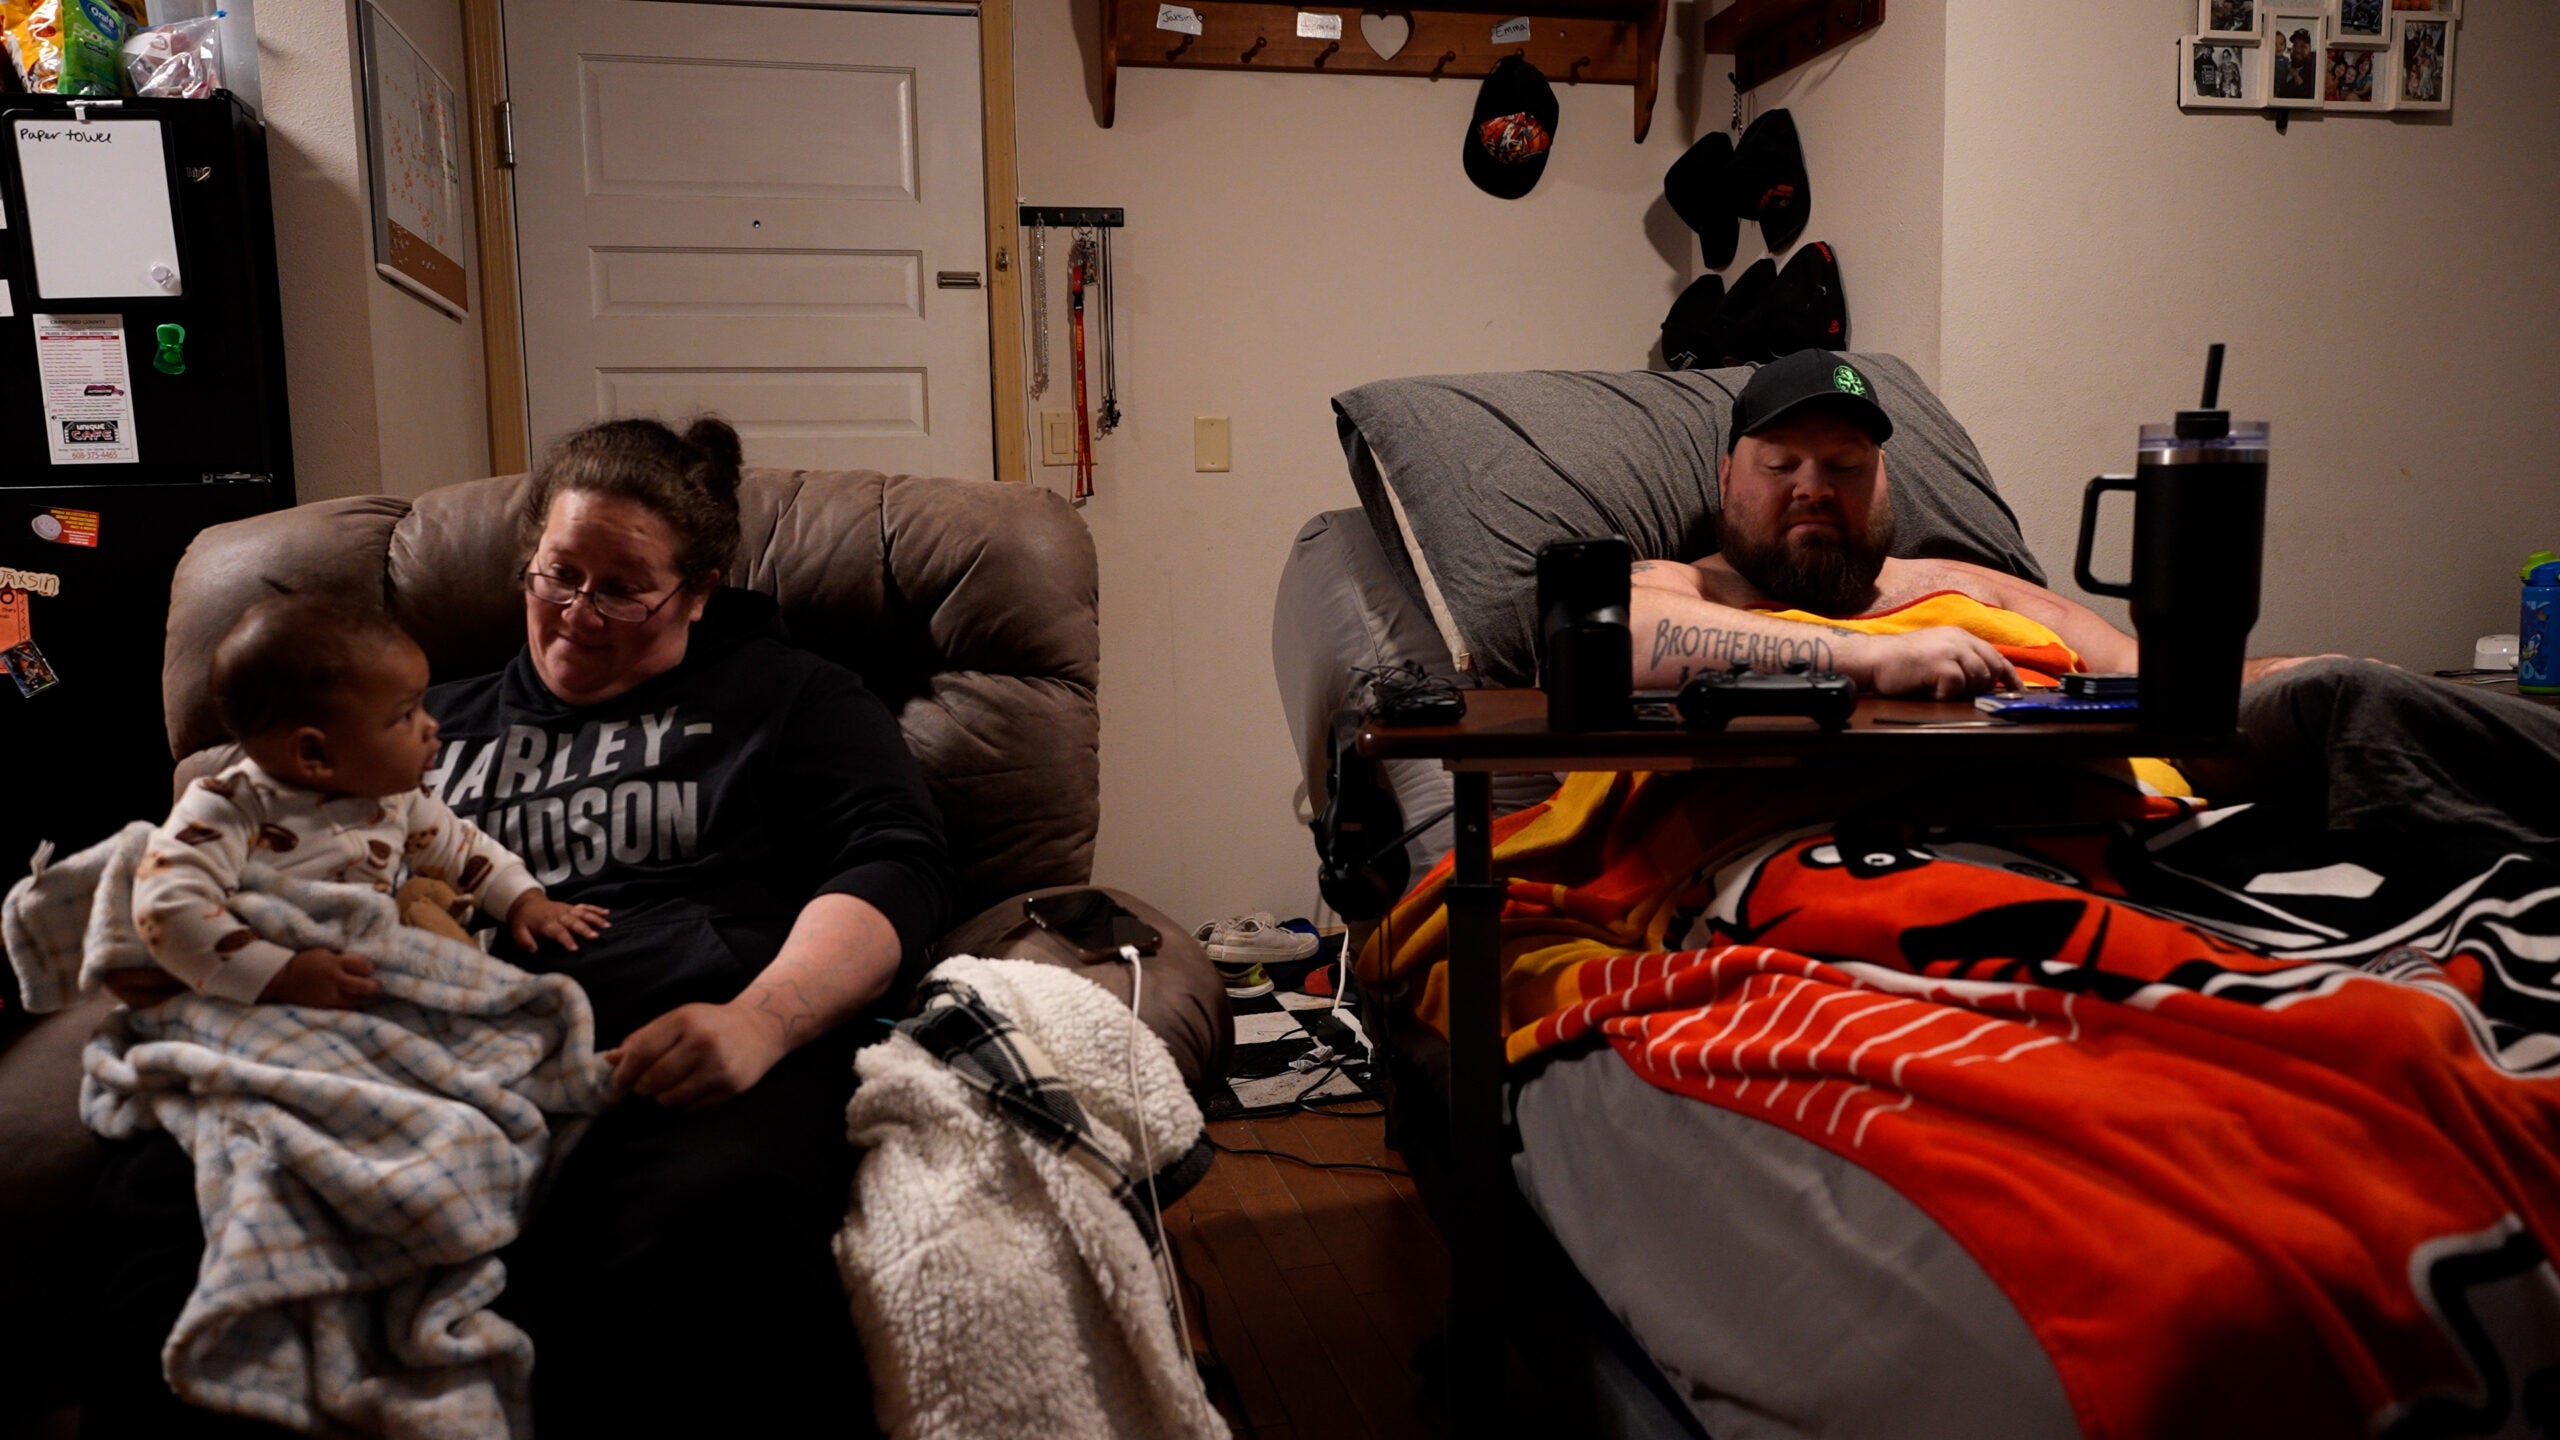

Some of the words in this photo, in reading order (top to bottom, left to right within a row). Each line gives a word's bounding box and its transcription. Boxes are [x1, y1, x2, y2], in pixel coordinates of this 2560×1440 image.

[1495, 23, 1528, 38] Emma
[20, 128, 60, 142] Paper
[71, 430, 113, 441] CAFE
[1651, 618, 1834, 674] BROTHERHOOD
